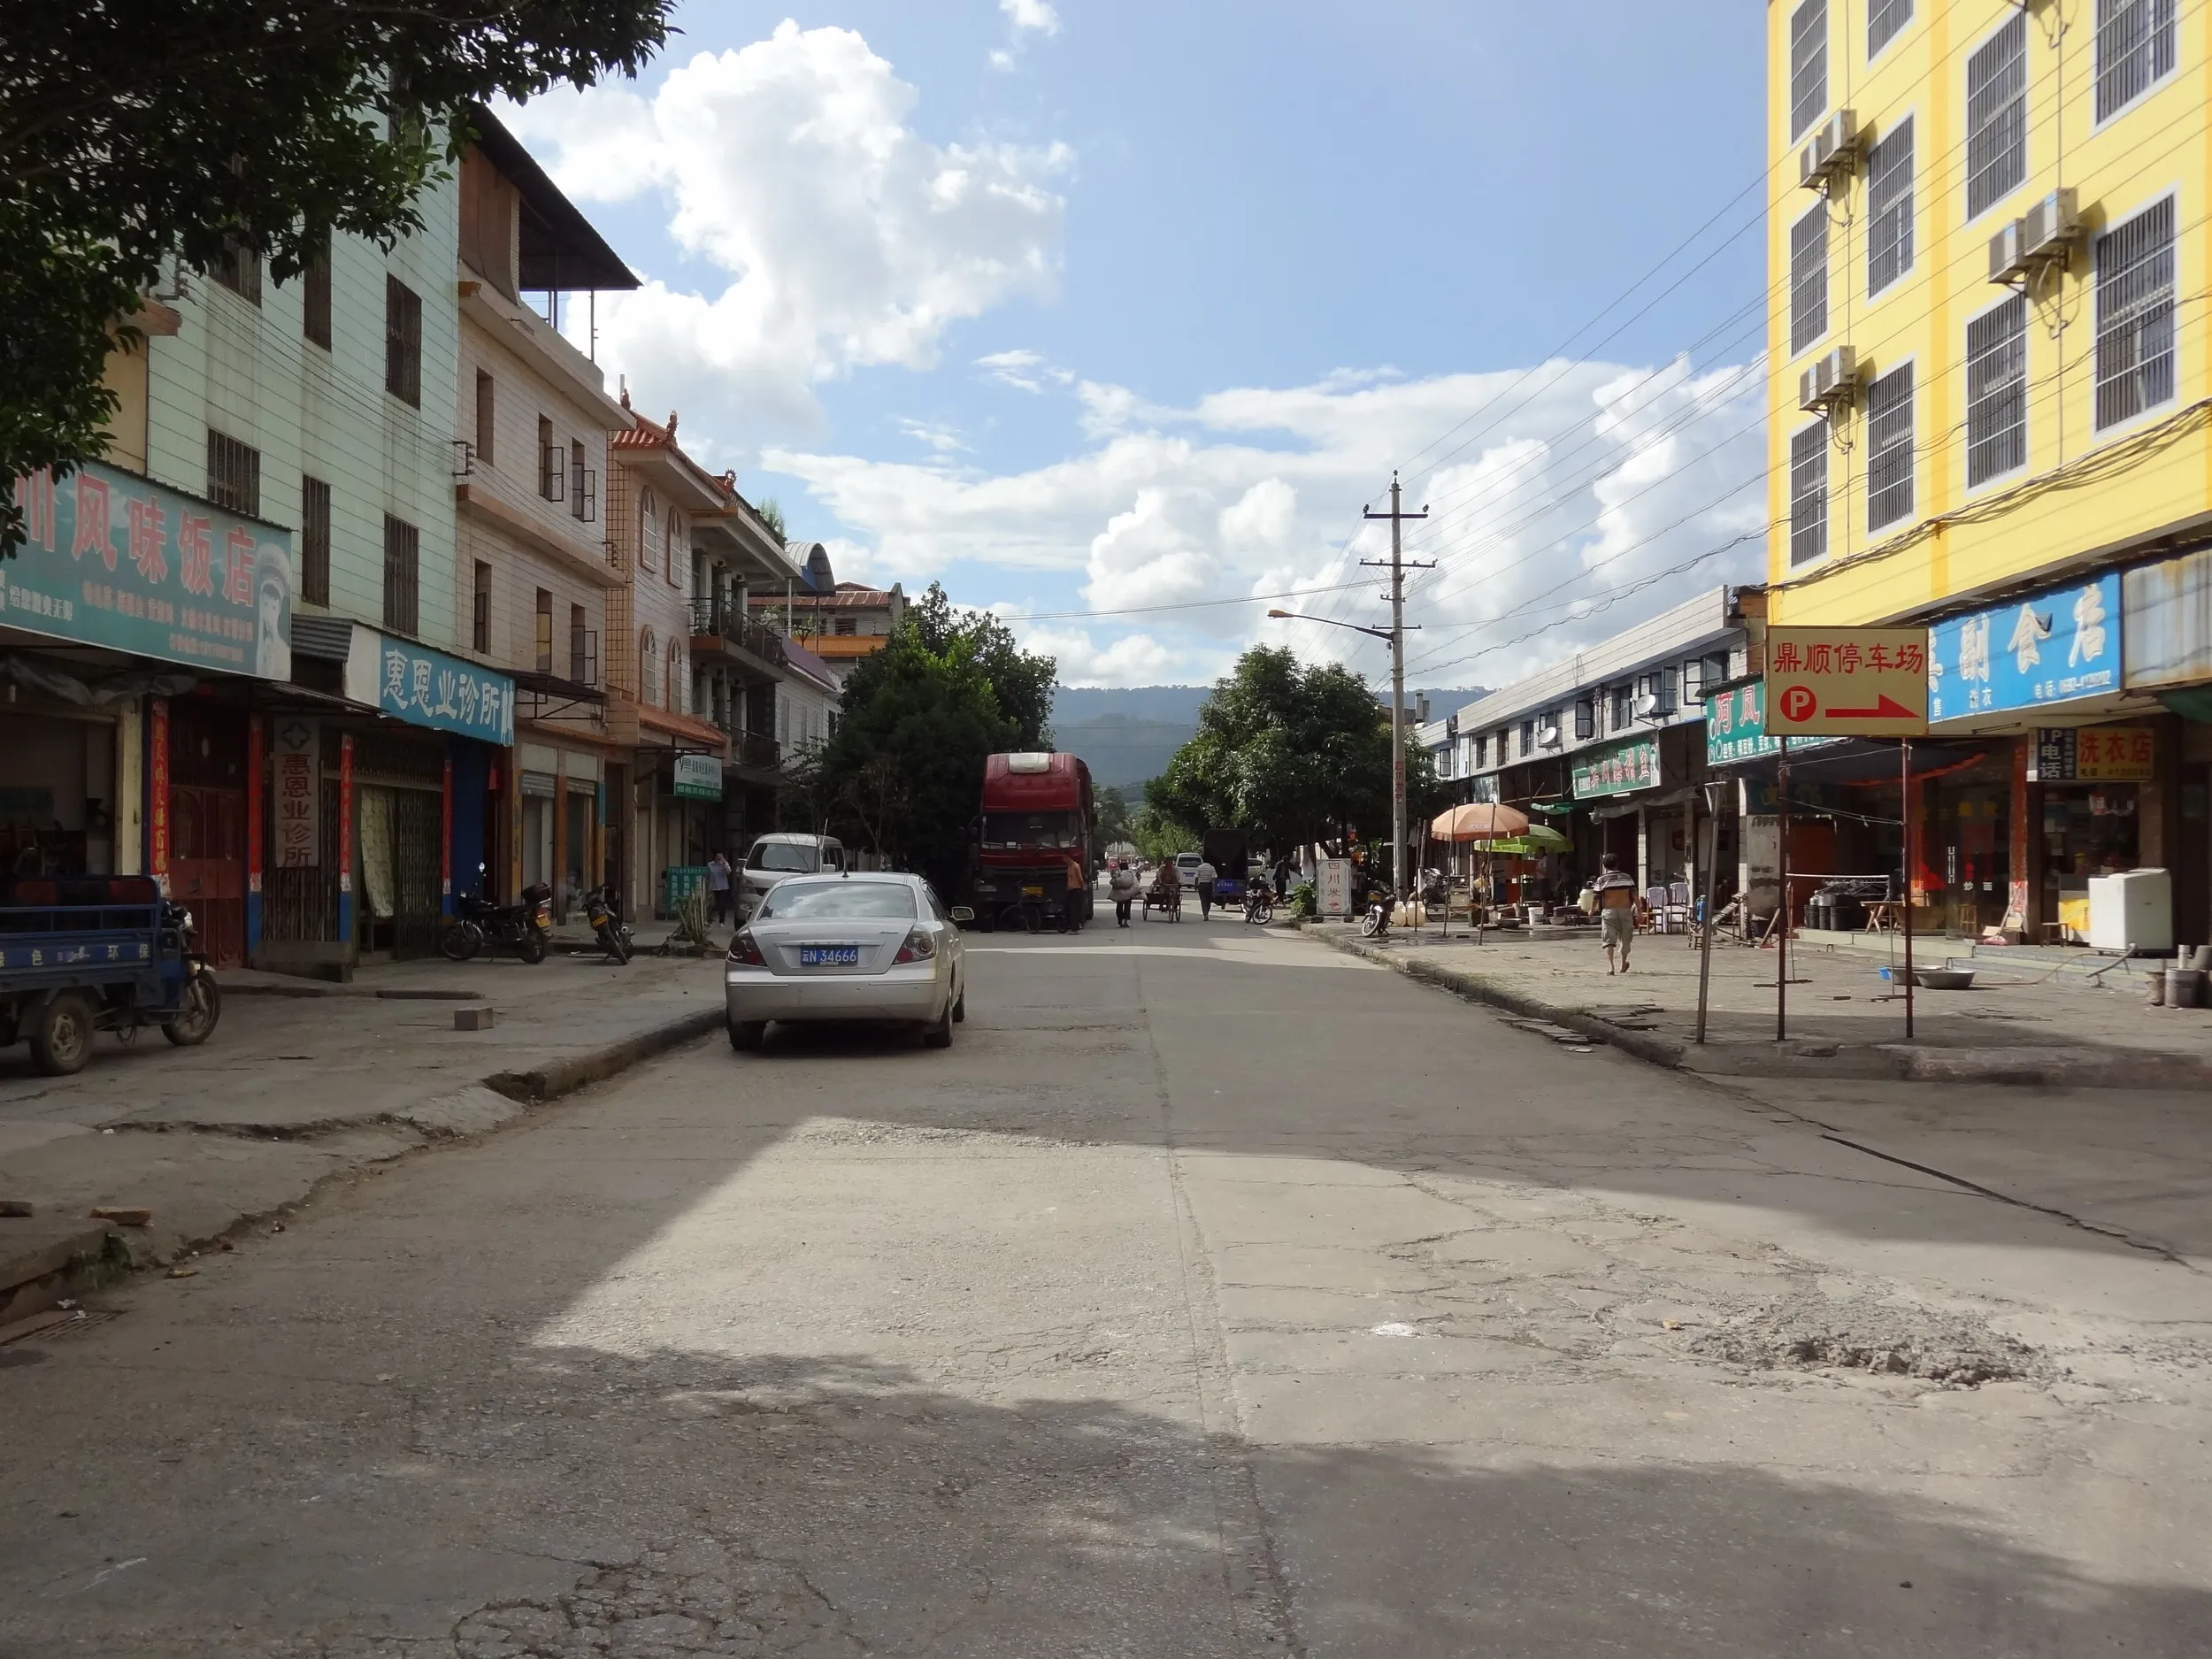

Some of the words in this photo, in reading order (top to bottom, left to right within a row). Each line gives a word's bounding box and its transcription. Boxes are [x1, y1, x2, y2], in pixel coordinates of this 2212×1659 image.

[1773, 641, 1924, 674] 鼎顺停车场
[383, 649, 500, 732] 惠恩业诊所
[2040, 729, 2062, 742] IP
[2079, 732, 2153, 764] 洗衣店
[2039, 743, 2062, 779] 电话
[281, 752, 312, 867] 惠恩业诊所
[108, 943, 150, 961] 环保
[820, 949, 856, 962] 34666
